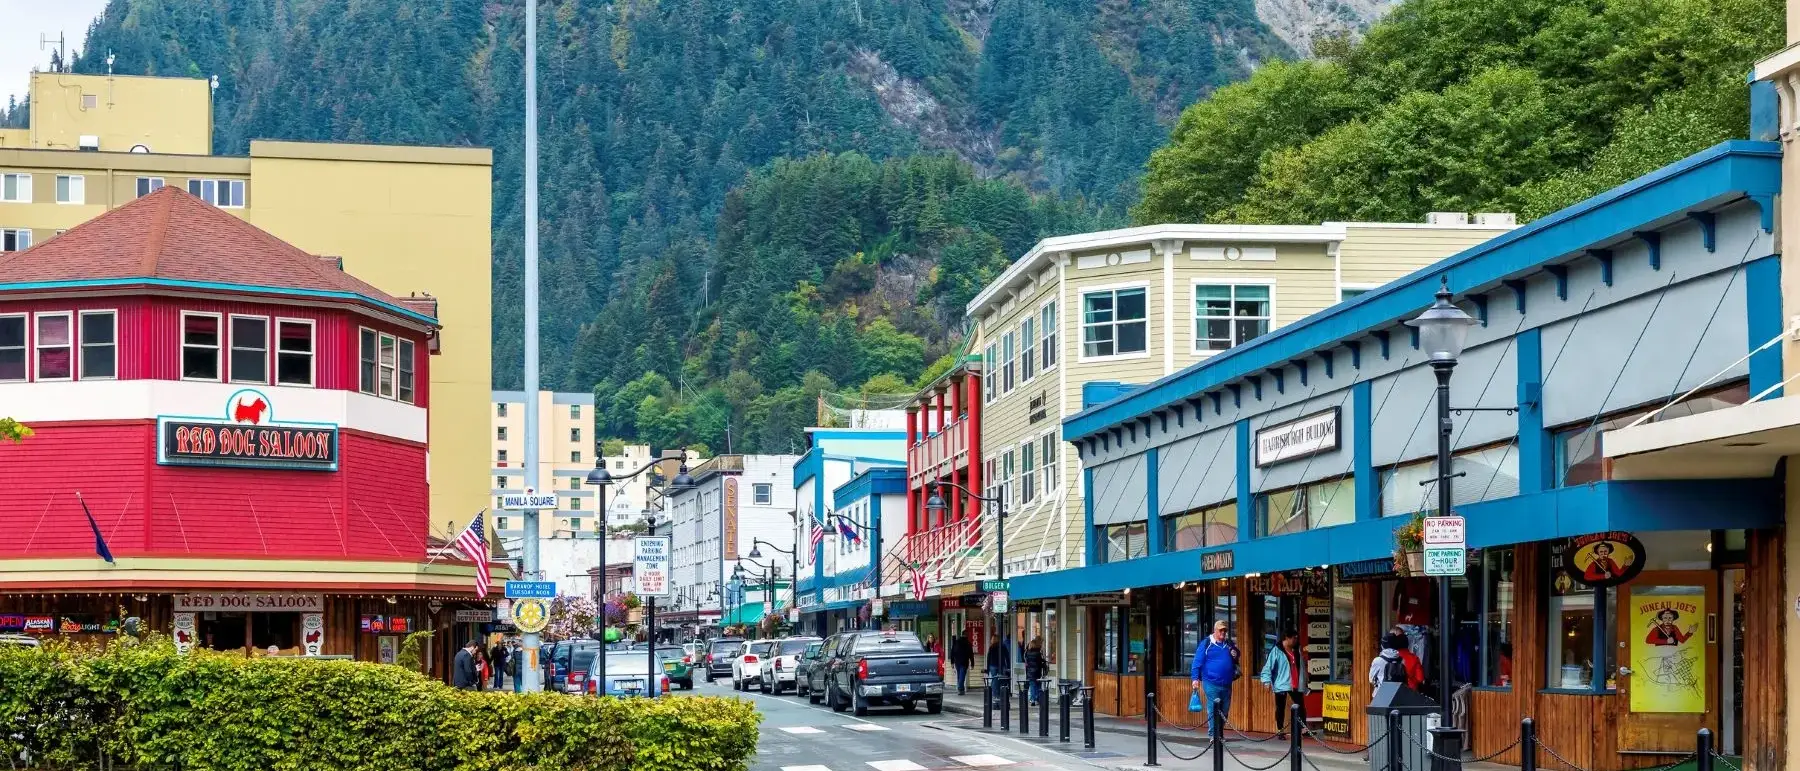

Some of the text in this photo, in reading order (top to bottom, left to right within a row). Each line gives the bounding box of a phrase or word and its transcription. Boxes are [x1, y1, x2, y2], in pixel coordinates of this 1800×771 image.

[1306, 420, 1334, 441] BUILDING
[175, 425, 330, 460] RED DOG SALOON
[505, 496, 554, 506] MANILA SQUARE
[727, 484, 736, 553] SENATE
[1431, 557, 1458, 565] 2-HOUR
[1249, 577, 1272, 592] RED
[180, 596, 317, 608] RED DOG SALOON
[1640, 601, 1697, 615] JUNEAU JOE'S
[0, 616, 23, 627] OPEN
[24, 619, 53, 630] ALASKAN
[81, 623, 100, 631] LIGHT
[967, 620, 984, 628] THE
[1327, 721, 1348, 733] OUTLET
